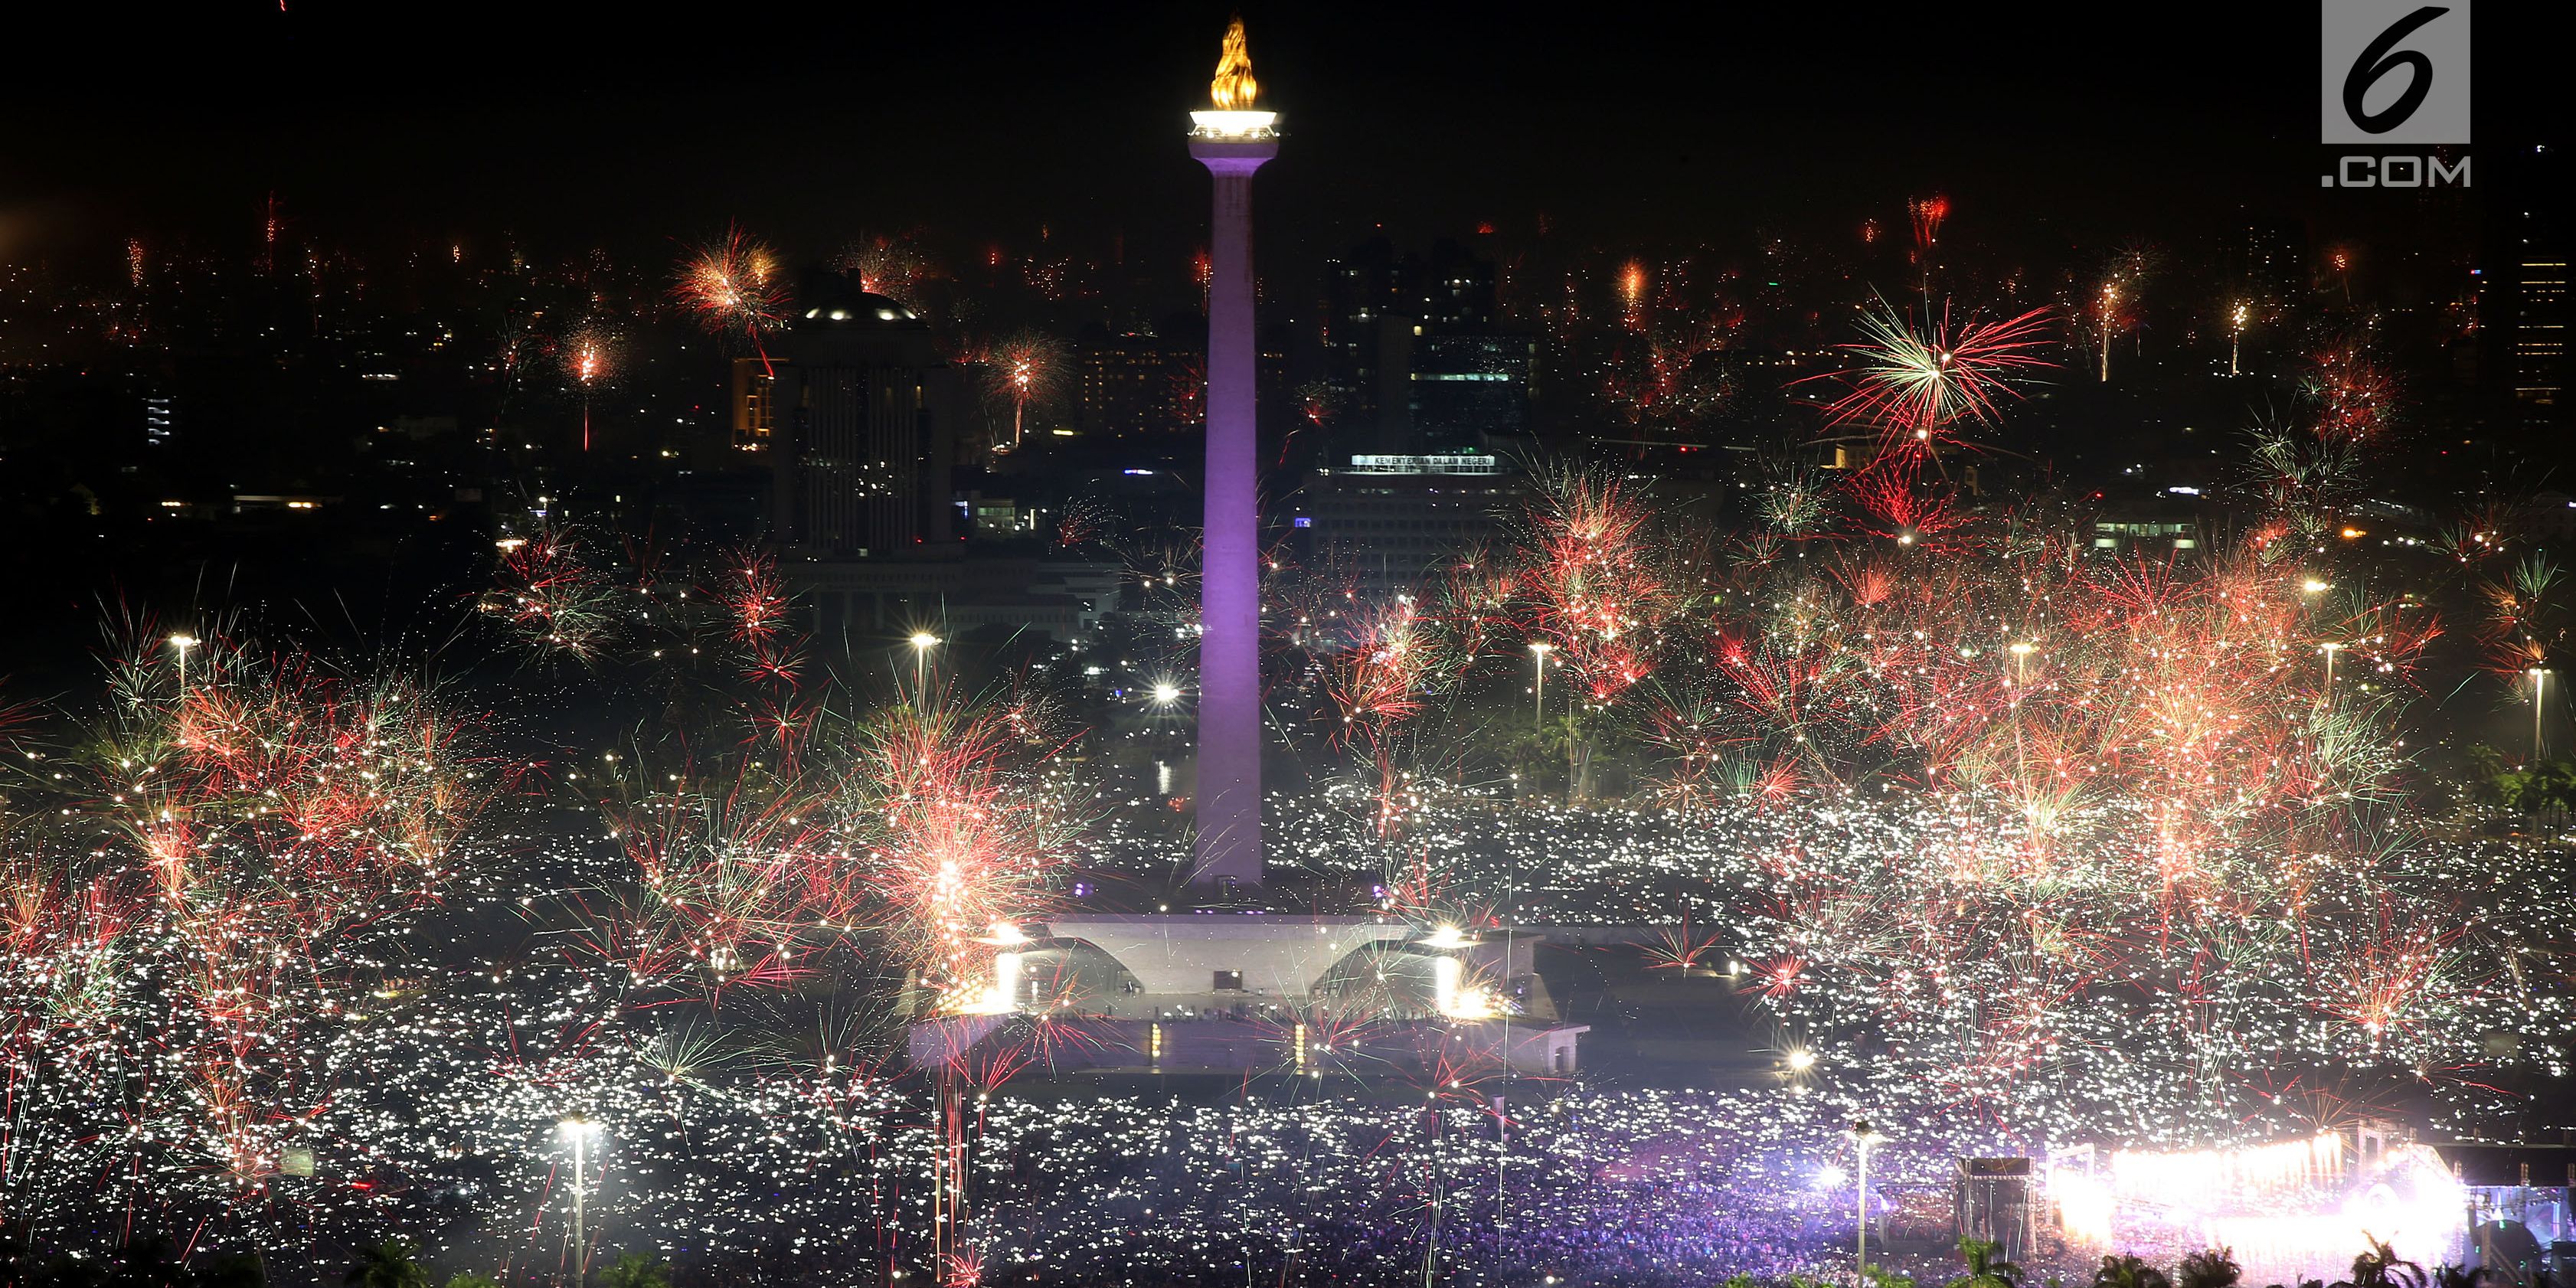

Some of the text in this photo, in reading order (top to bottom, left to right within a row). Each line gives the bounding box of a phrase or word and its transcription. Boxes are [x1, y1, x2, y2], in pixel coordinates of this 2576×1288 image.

[1375, 456, 1491, 466] KEMENTERIAN DALAM NEGERI
